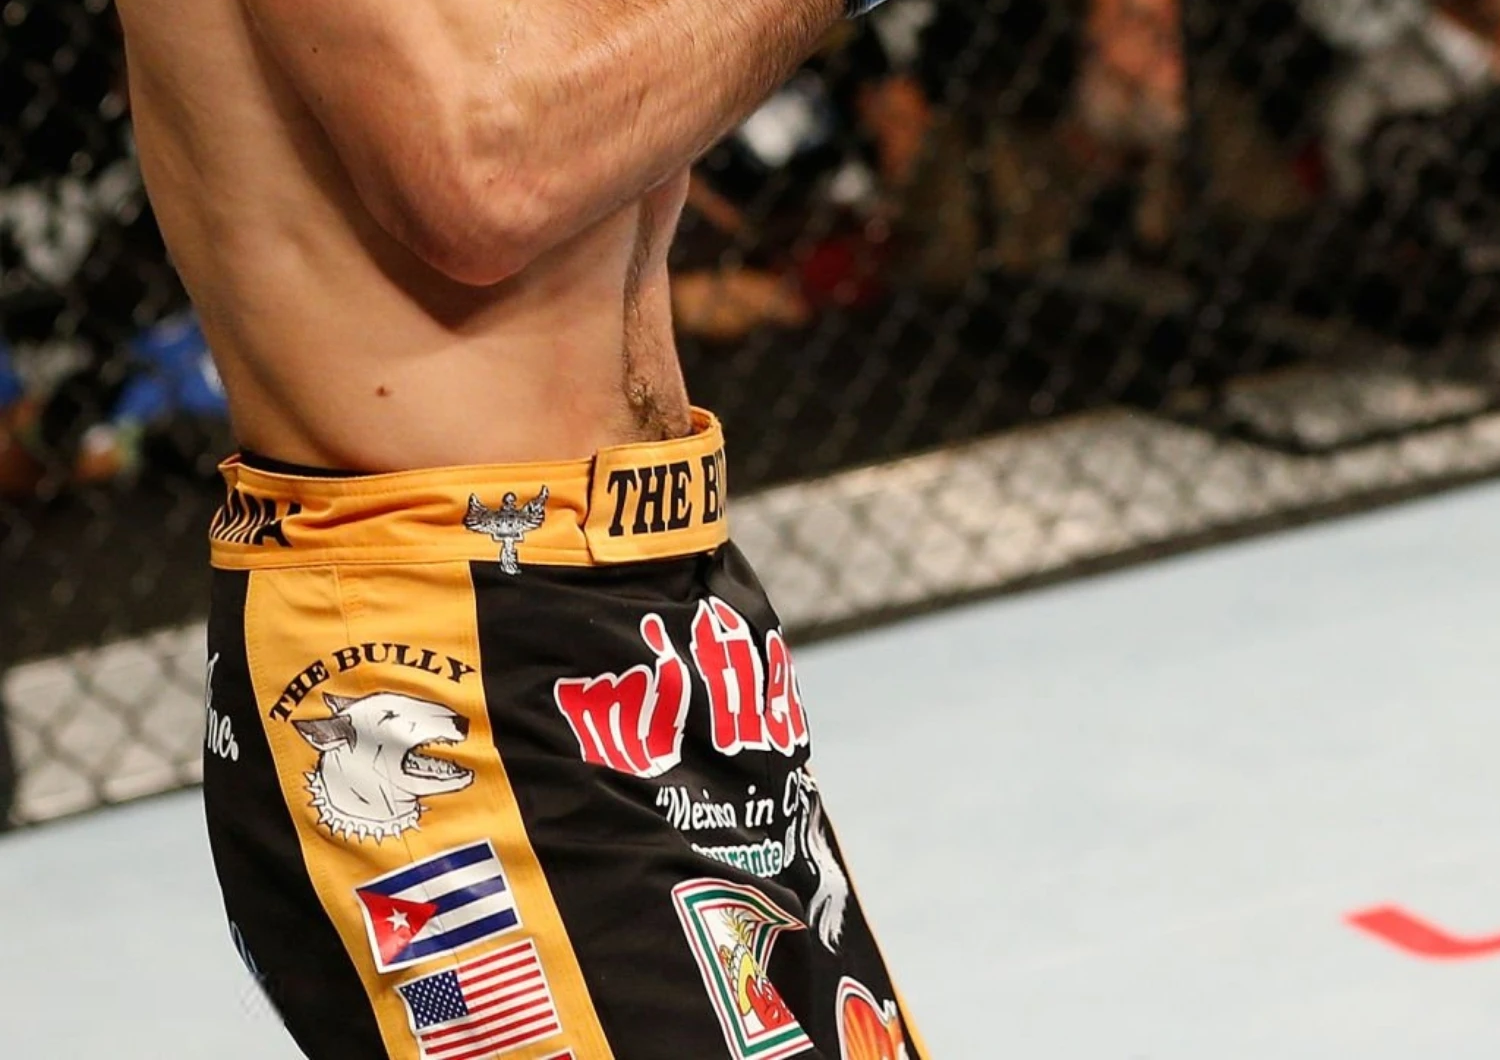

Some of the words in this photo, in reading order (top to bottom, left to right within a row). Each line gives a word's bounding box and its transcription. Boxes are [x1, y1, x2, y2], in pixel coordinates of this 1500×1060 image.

[607, 460, 692, 537] THE
[269, 660, 331, 722] THE
[332, 642, 477, 684] BULLY
[745, 785, 774, 828] in
